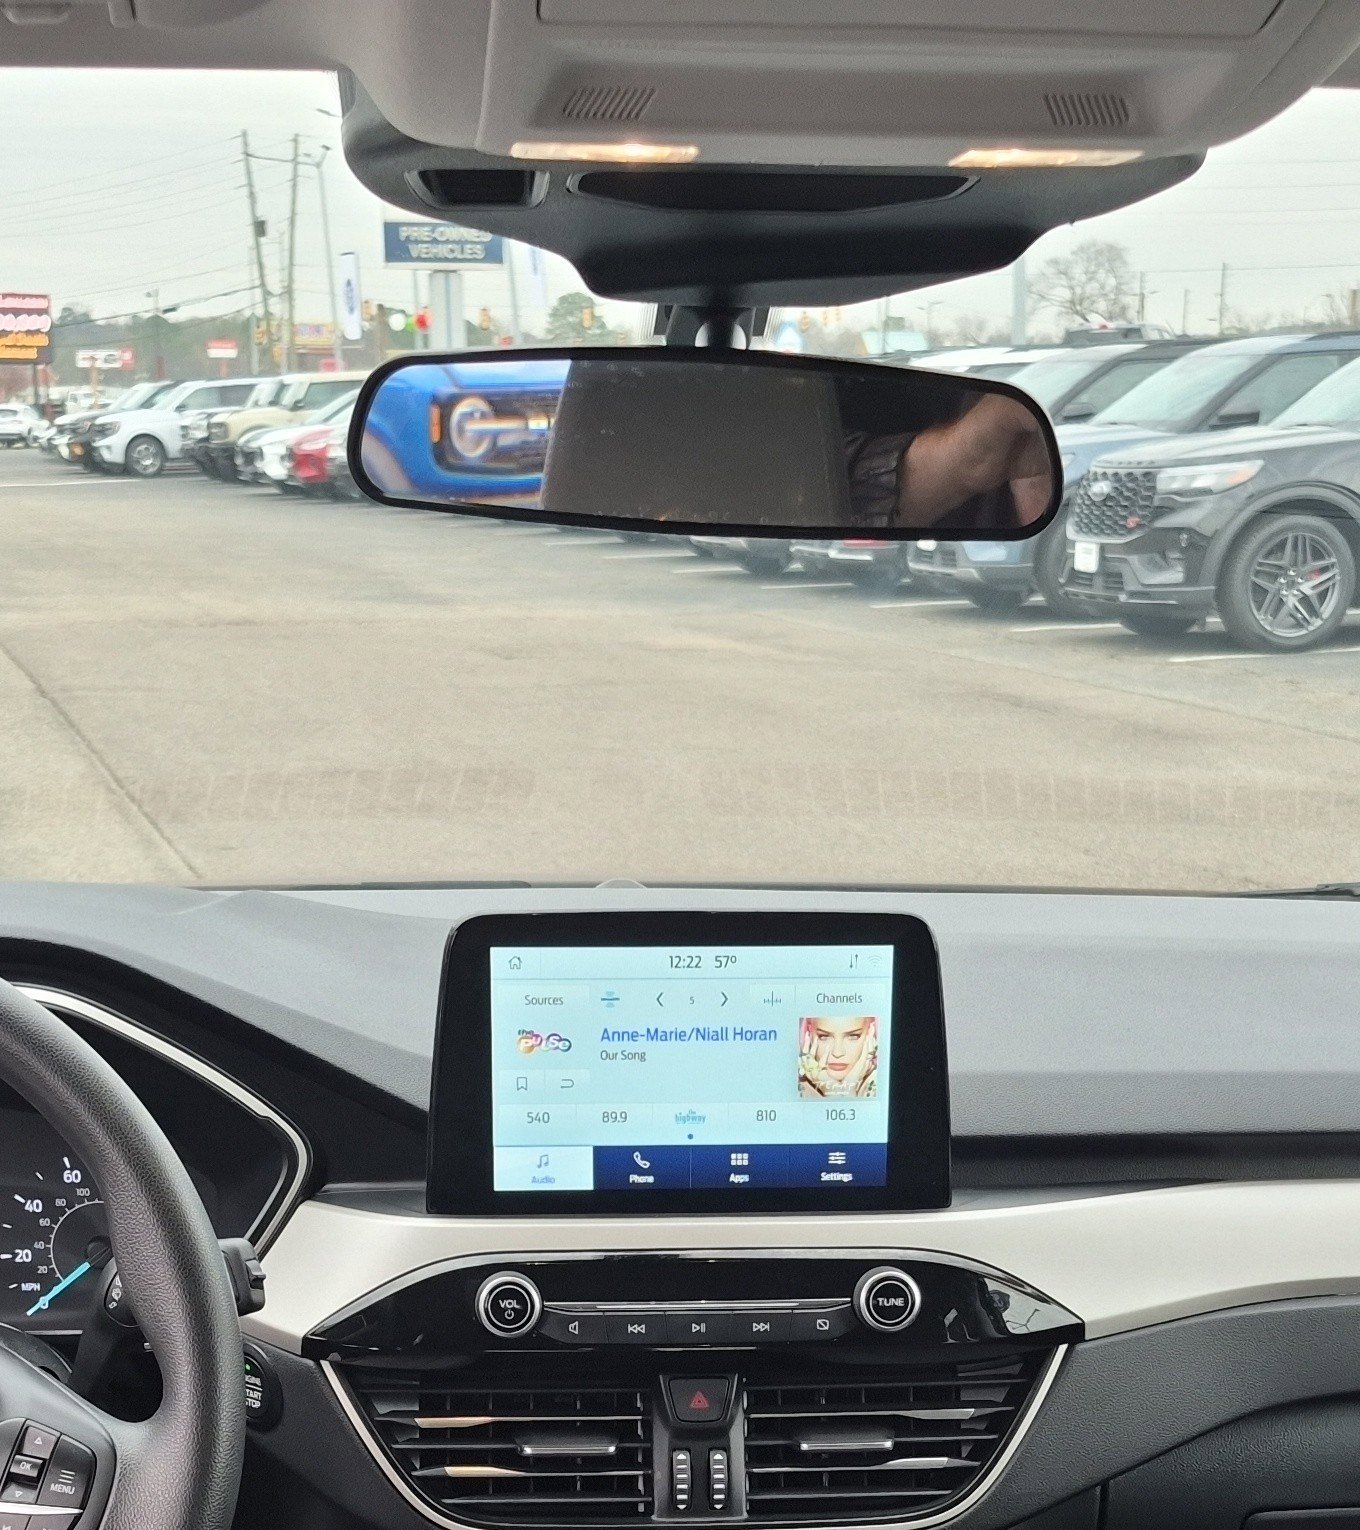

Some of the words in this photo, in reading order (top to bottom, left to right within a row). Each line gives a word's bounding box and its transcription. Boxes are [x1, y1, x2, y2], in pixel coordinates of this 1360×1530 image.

[398, 226, 493, 242] PRE-OWNED
[408, 243, 486, 259] VEHICLES
[669, 955, 702, 969] 12:22
[524, 994, 564, 1006] Sources
[689, 996, 695, 1005] 5
[816, 992, 863, 1004] Channels
[600, 1026, 729, 1042] Anne-Marie/Niall
[733, 1026, 778, 1041] Horan
[600, 1050, 618, 1061] Our
[621, 1050, 647, 1062] Song
[527, 1111, 550, 1124] 540
[602, 1111, 628, 1123] 89.9
[756, 1109, 777, 1122] 810
[826, 1108, 856, 1121] 106.3
[63, 1169, 82, 1184] 60
[531, 1175, 556, 1184] Audio
[629, 1174, 655, 1184] Phone
[729, 1173, 750, 1184] Apps
[820, 1172, 853, 1183] Settings
[75, 1188, 90, 1197] 100
[24, 1199, 43, 1213] 40
[39, 1218, 51, 1227] 60
[33, 1241, 45, 1250] 40
[14, 1249, 32, 1263] 20
[37, 1265, 48, 1274] 20
[21, 1282, 41, 1292] MPH
[499, 1299, 521, 1309] VOL
[877, 1298, 905, 1307] TUNE
[19, 1461, 32, 1471] OK
[50, 1483, 76, 1495] MENU
